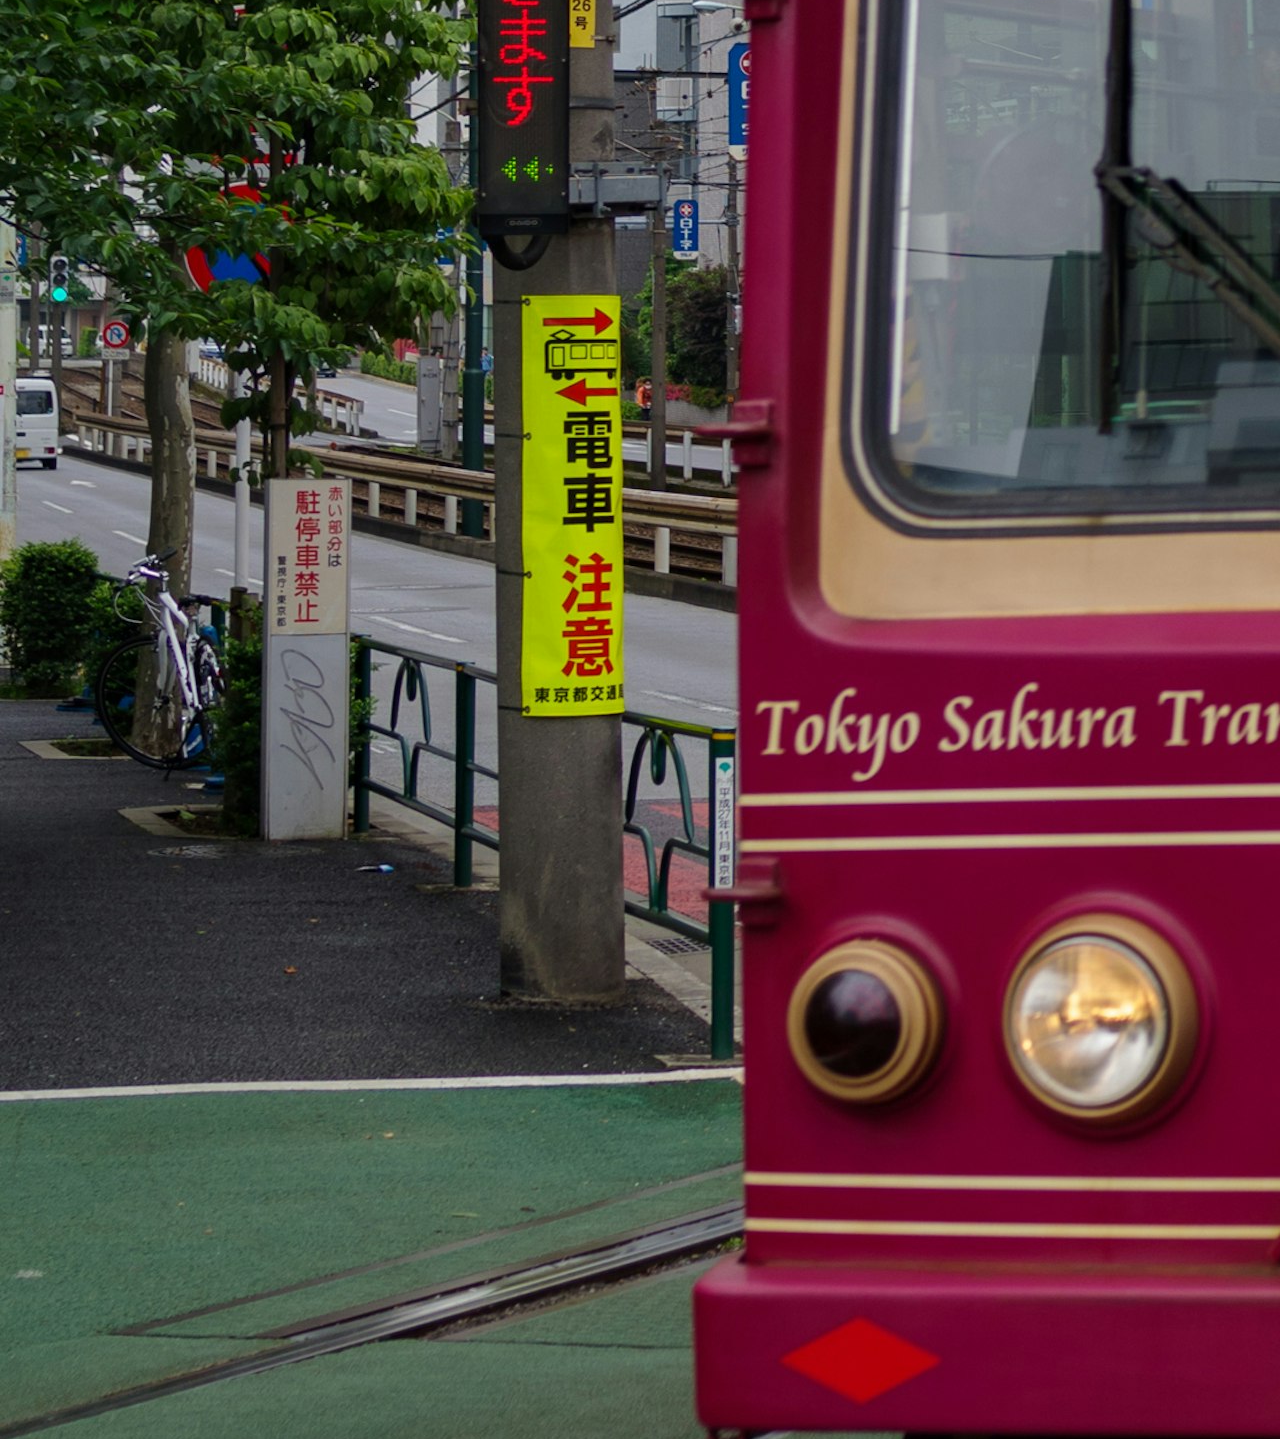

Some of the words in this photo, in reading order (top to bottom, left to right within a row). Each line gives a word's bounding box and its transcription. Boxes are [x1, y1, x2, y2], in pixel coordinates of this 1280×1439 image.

[327, 486, 343, 567] 赤い部分は
[562, 410, 615, 533] 電車
[294, 490, 321, 623] 駐停車禁止
[561, 552, 614, 677] 注意
[756, 687, 920, 783] Tokyo
[938, 682, 1136, 753] Sakura
